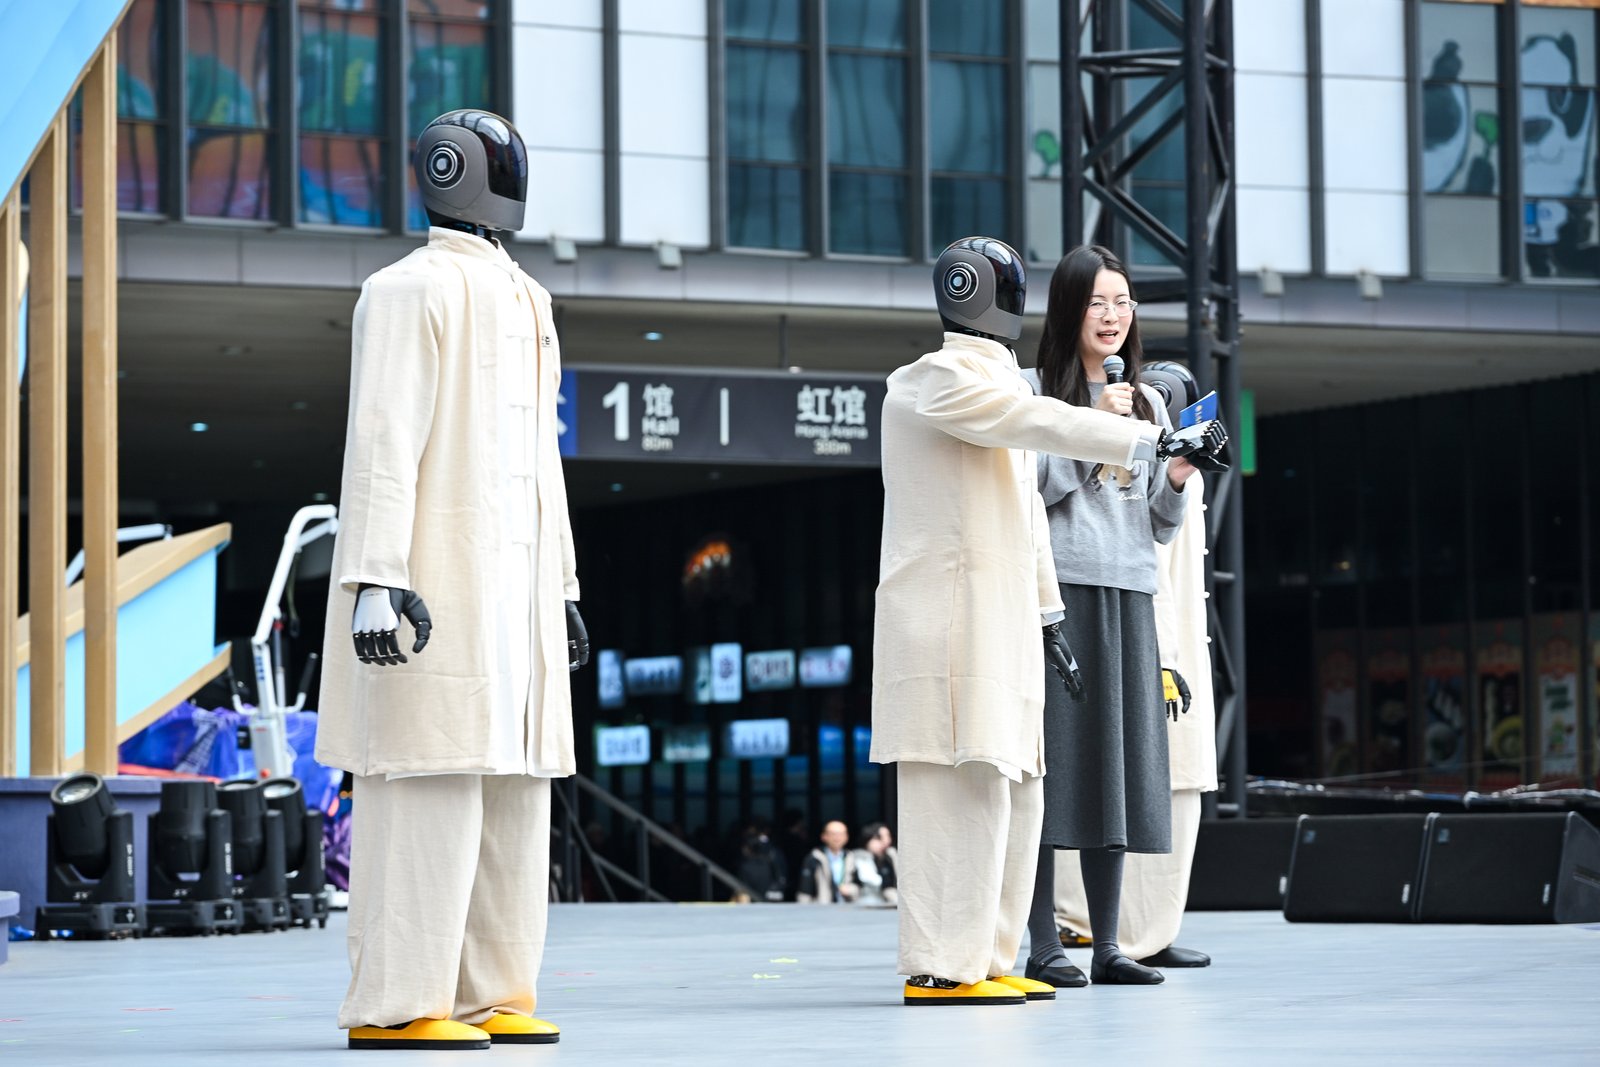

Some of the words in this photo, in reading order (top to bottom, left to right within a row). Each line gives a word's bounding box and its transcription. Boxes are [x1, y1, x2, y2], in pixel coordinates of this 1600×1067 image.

[603, 382, 630, 441] 1
[643, 384, 674, 417] 馆
[797, 385, 866, 425] 虹馆
[642, 417, 680, 436] Hall
[830, 425, 868, 440] Arena
